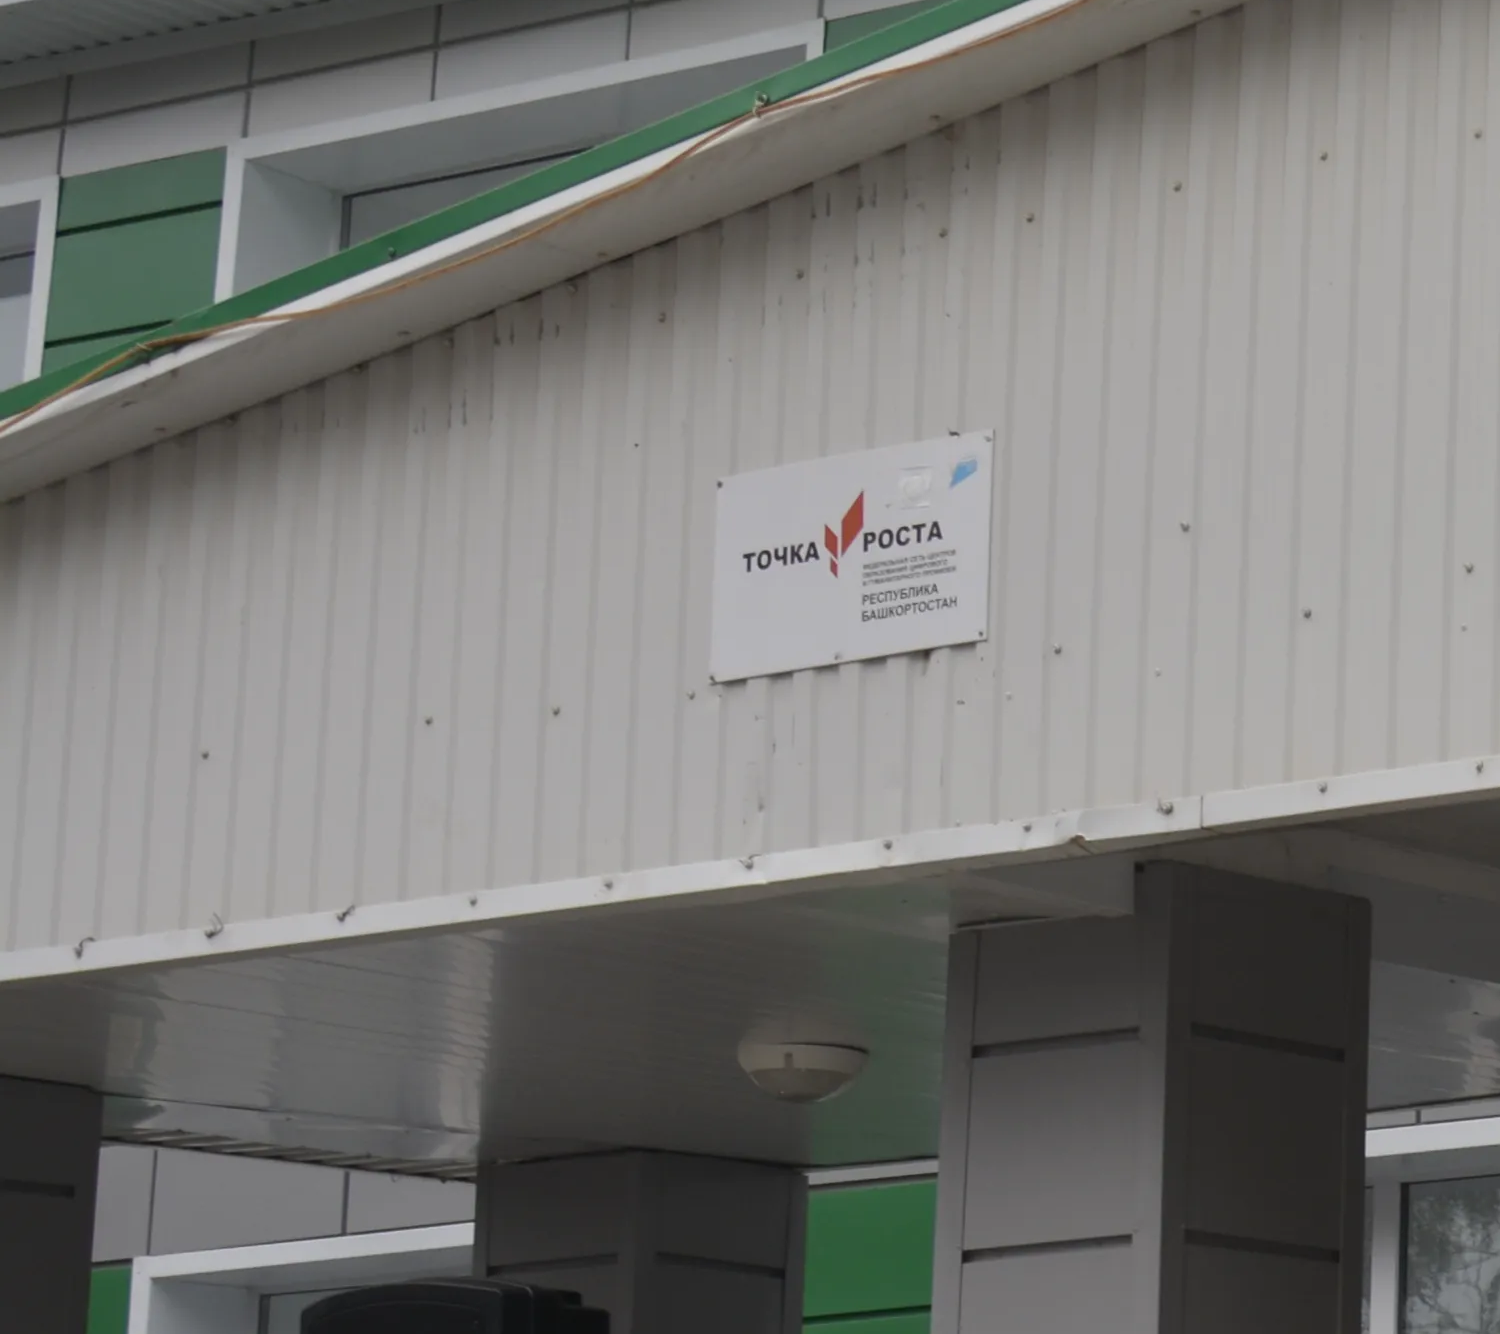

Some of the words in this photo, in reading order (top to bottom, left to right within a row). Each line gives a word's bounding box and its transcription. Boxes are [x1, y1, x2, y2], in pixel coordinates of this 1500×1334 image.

[742, 540, 820, 573] ТОЧКА
[862, 520, 943, 552] РОСТА
[862, 583, 939, 606] РЕСПУБЛИКА
[861, 596, 958, 622] БАШКОРТОСТАН
